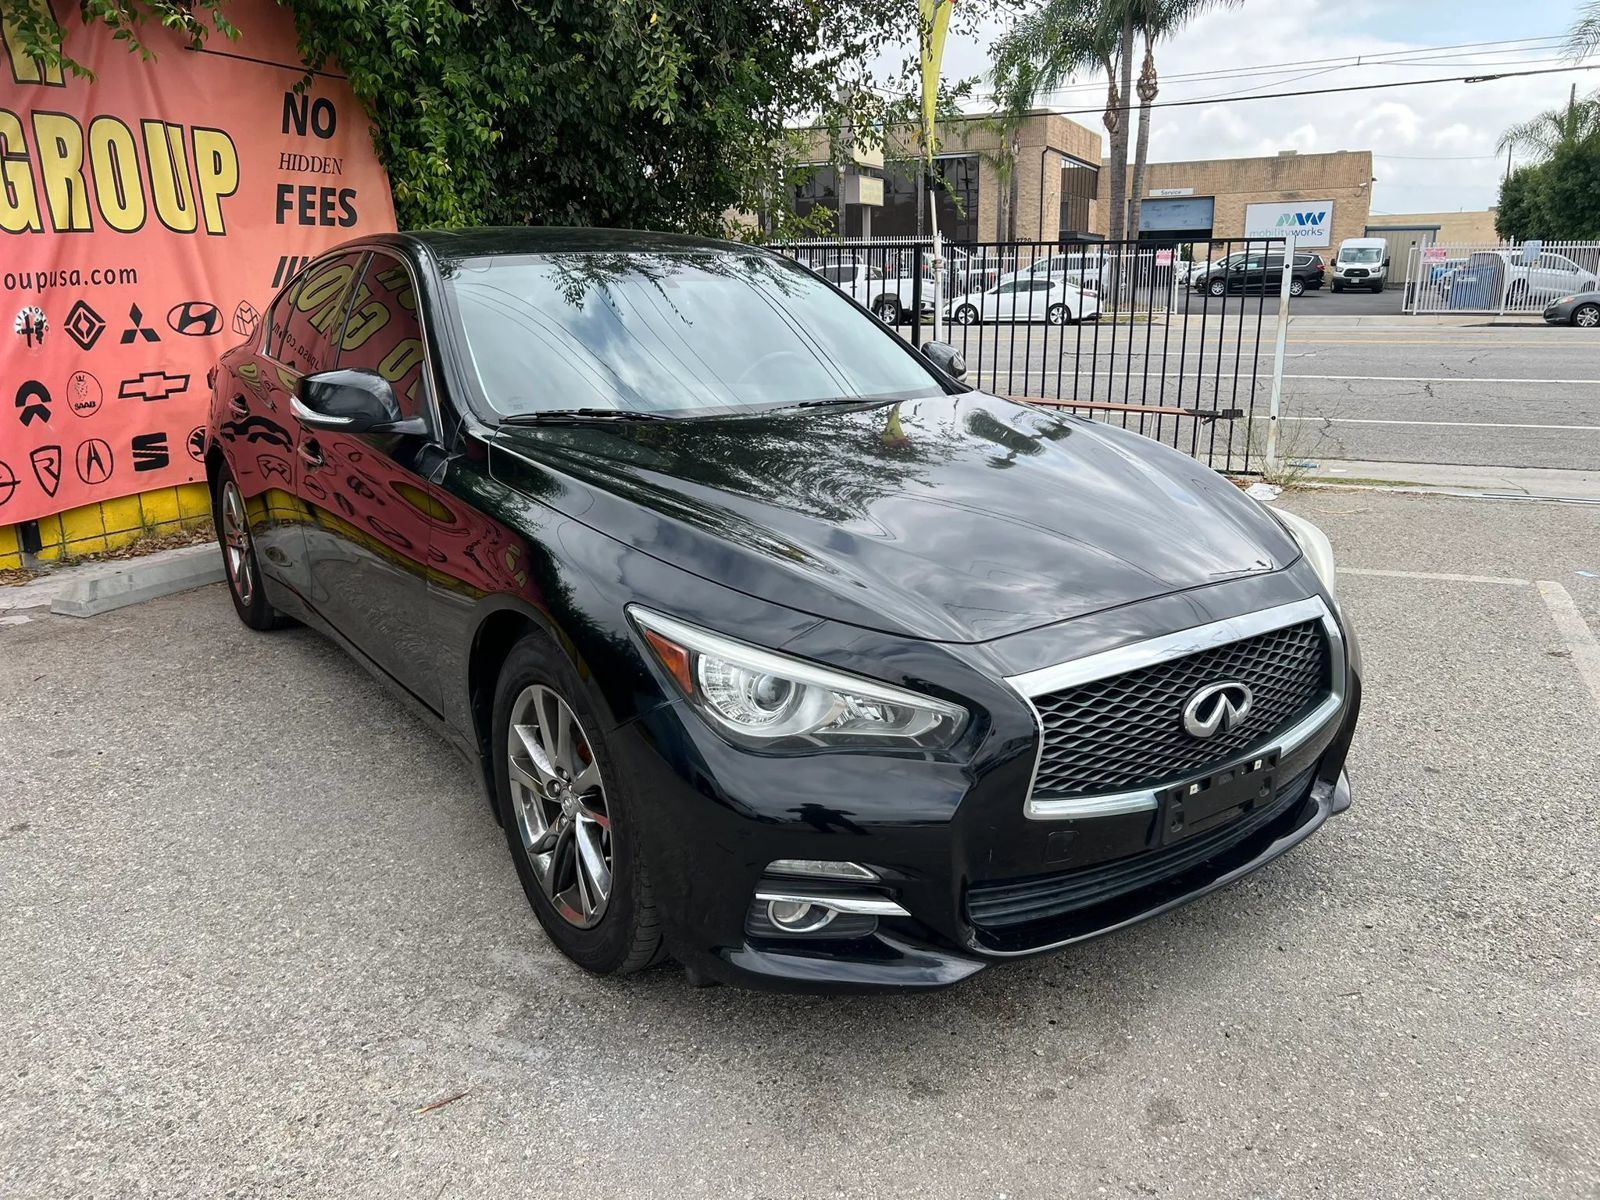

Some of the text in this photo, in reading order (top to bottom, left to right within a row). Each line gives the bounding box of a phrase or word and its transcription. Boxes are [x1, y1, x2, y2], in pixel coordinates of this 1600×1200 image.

[281, 92, 337, 140] NO
[0, 108, 240, 236] GROUP
[278, 152, 343, 176] HIDDEN
[275, 183, 358, 228] FEES
[4, 268, 138, 294] oupusa.com
[74, 401, 96, 411] SAAB
